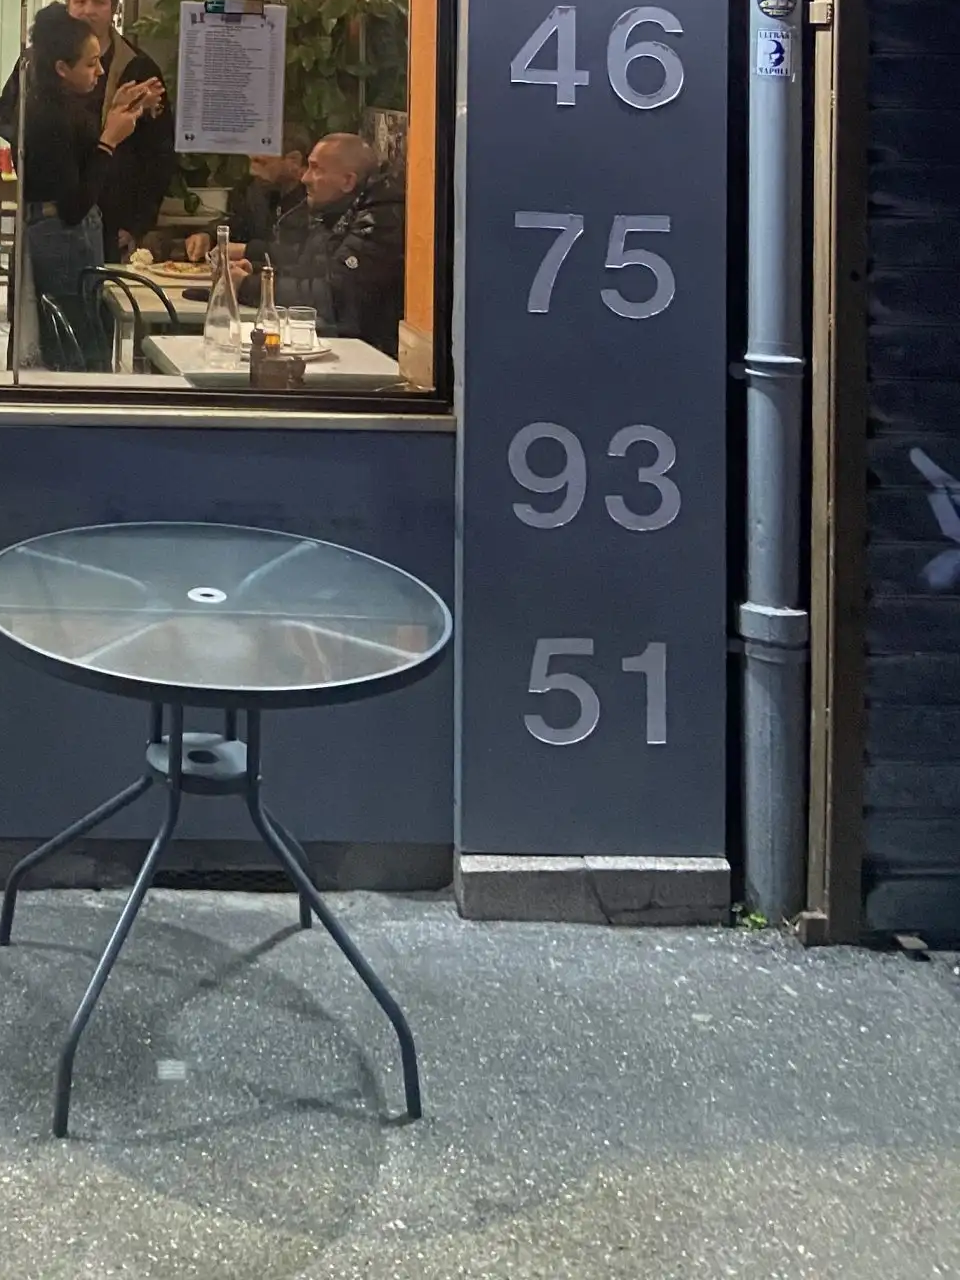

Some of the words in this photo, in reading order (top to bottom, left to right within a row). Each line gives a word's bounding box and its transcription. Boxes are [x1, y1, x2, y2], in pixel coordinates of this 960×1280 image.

[510, 5, 685, 110] 46
[513, 211, 676, 320] 75
[507, 421, 682, 532] 93
[523, 637, 668, 746] 51
